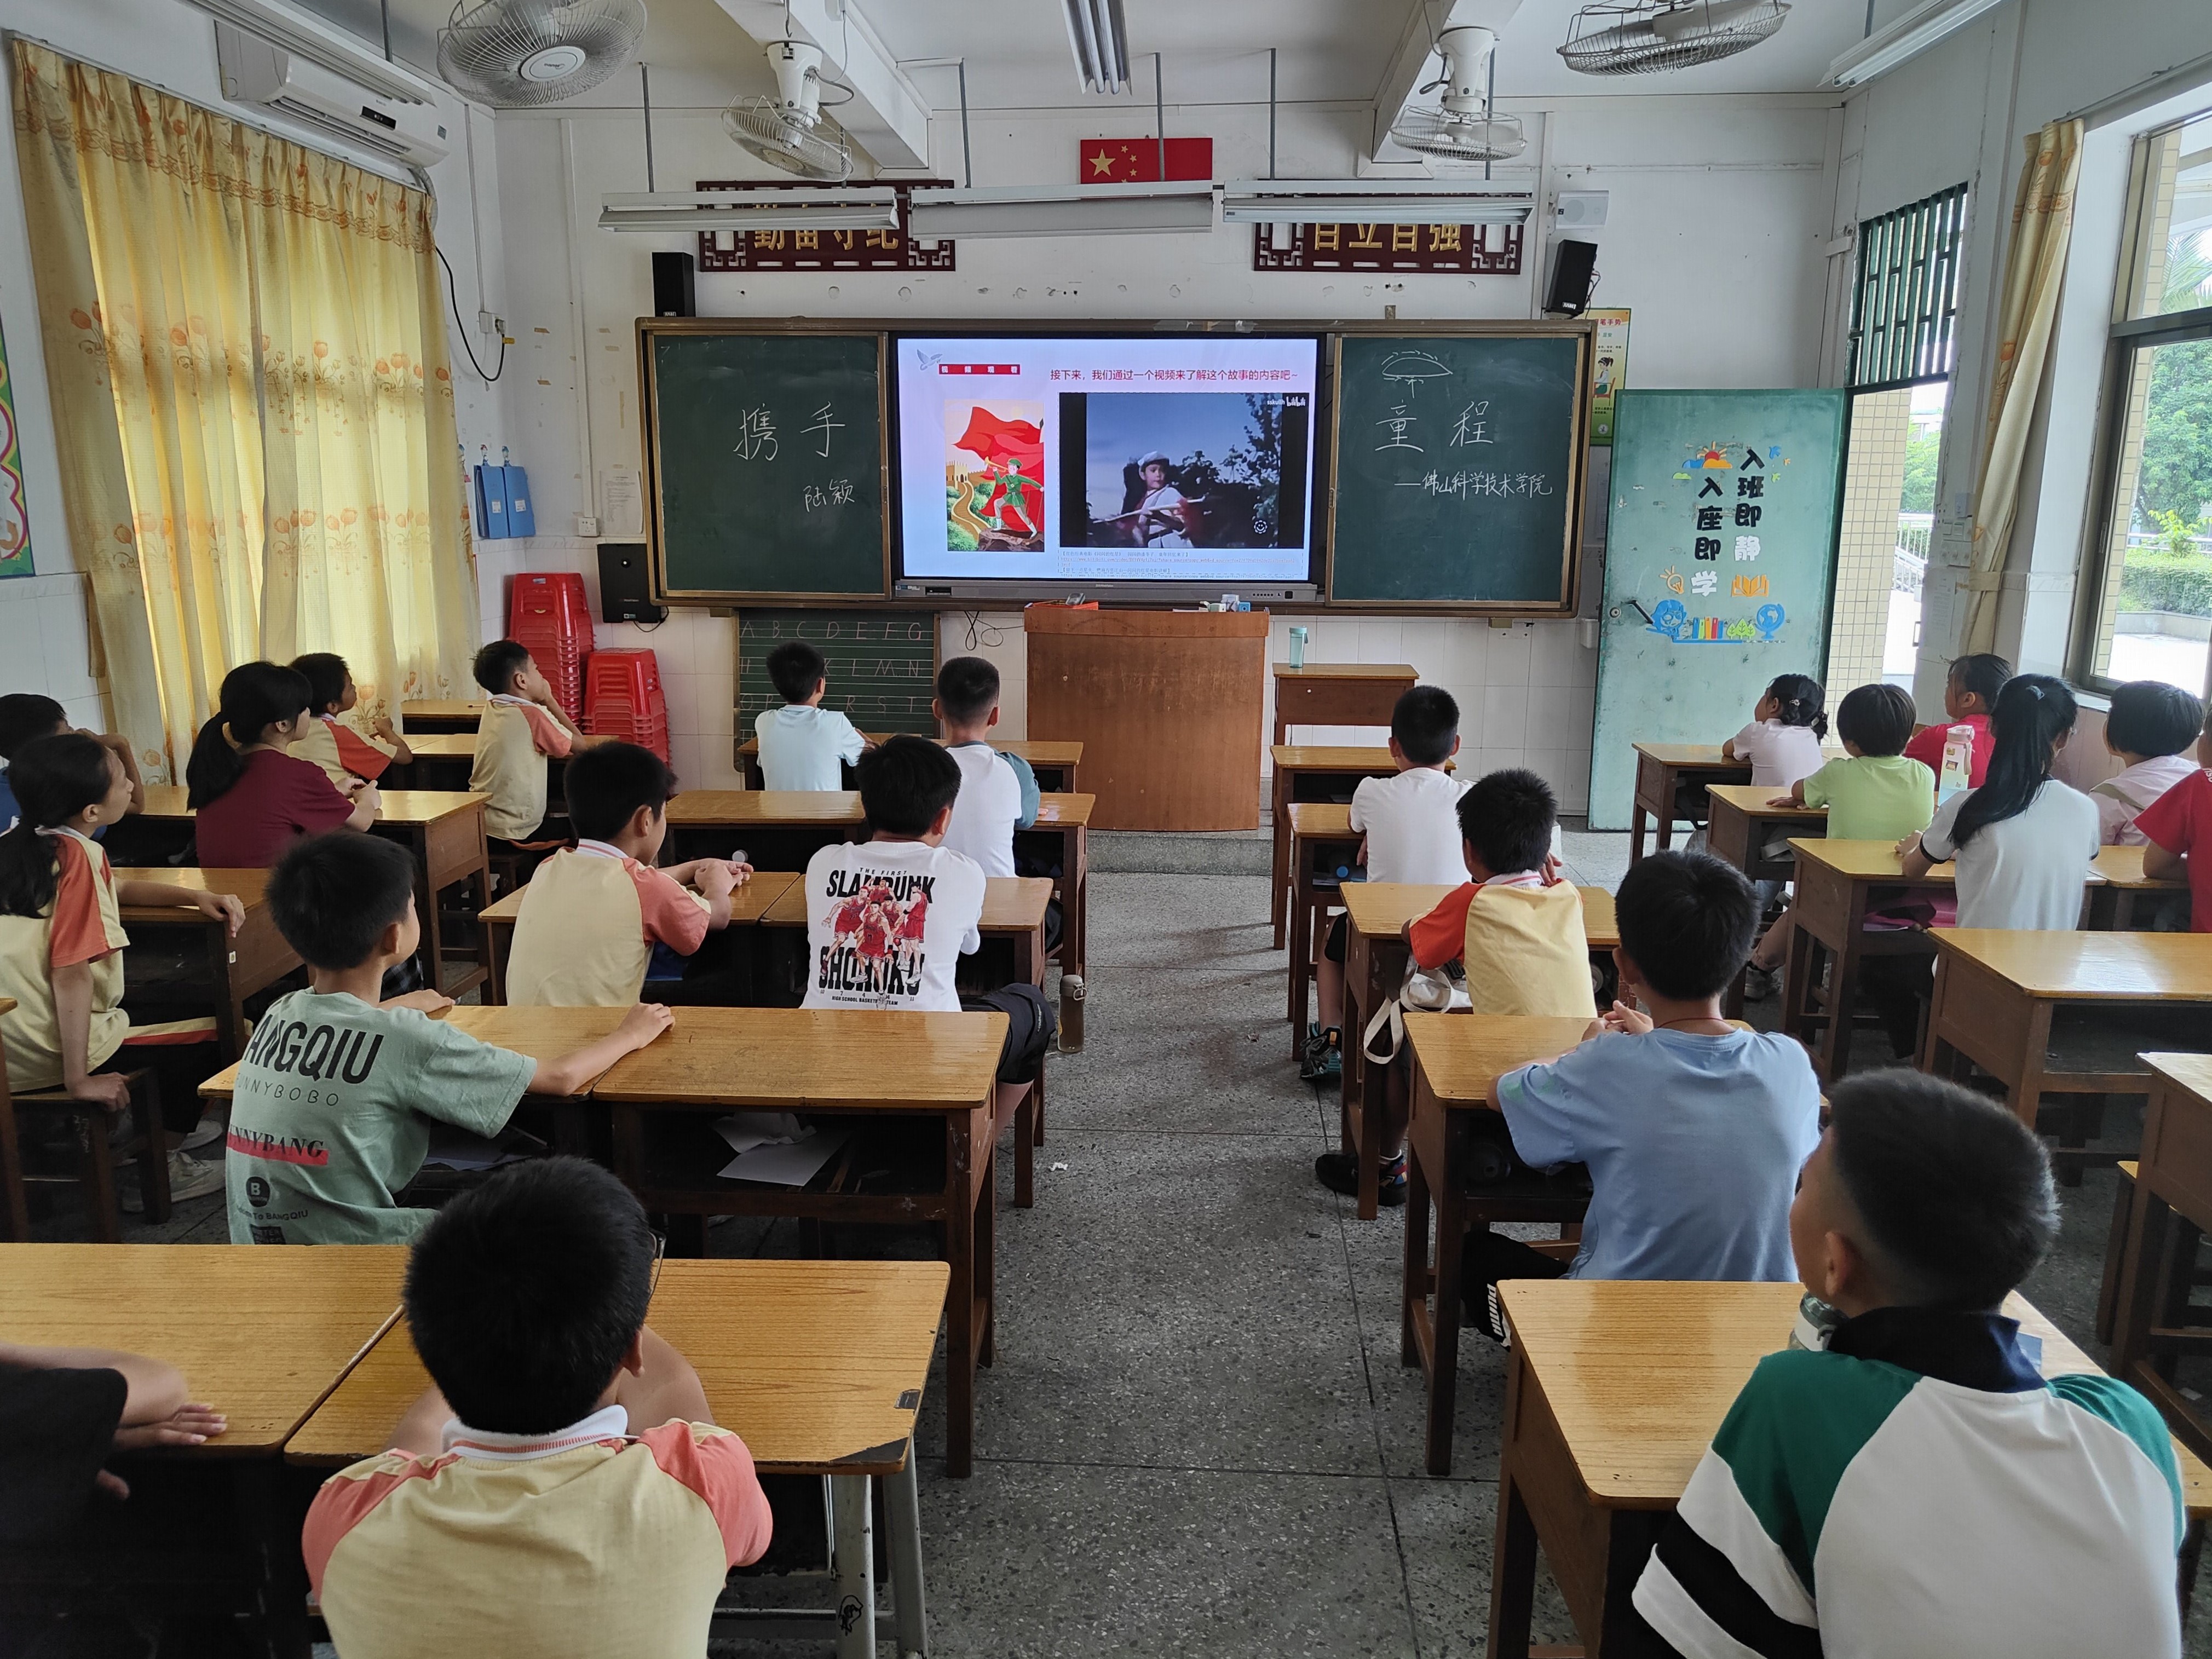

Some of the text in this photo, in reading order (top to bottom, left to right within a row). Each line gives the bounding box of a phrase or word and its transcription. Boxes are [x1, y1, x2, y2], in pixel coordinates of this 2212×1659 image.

[1734, 448, 1765, 562] 入班即静
[1690, 476, 1724, 597] 入座即学
[741, 621, 755, 638] A
[797, 621, 807, 638] C
[826, 621, 839, 639] D
[856, 622, 868, 640] E
[884, 622, 897, 640] F
[908, 623, 922, 640] G
[874, 660, 895, 677] M
[909, 660, 919, 677] N
[846, 696, 856, 712] R
[860, 867, 875, 875] THE
[250, 1182, 261, 1196] B
